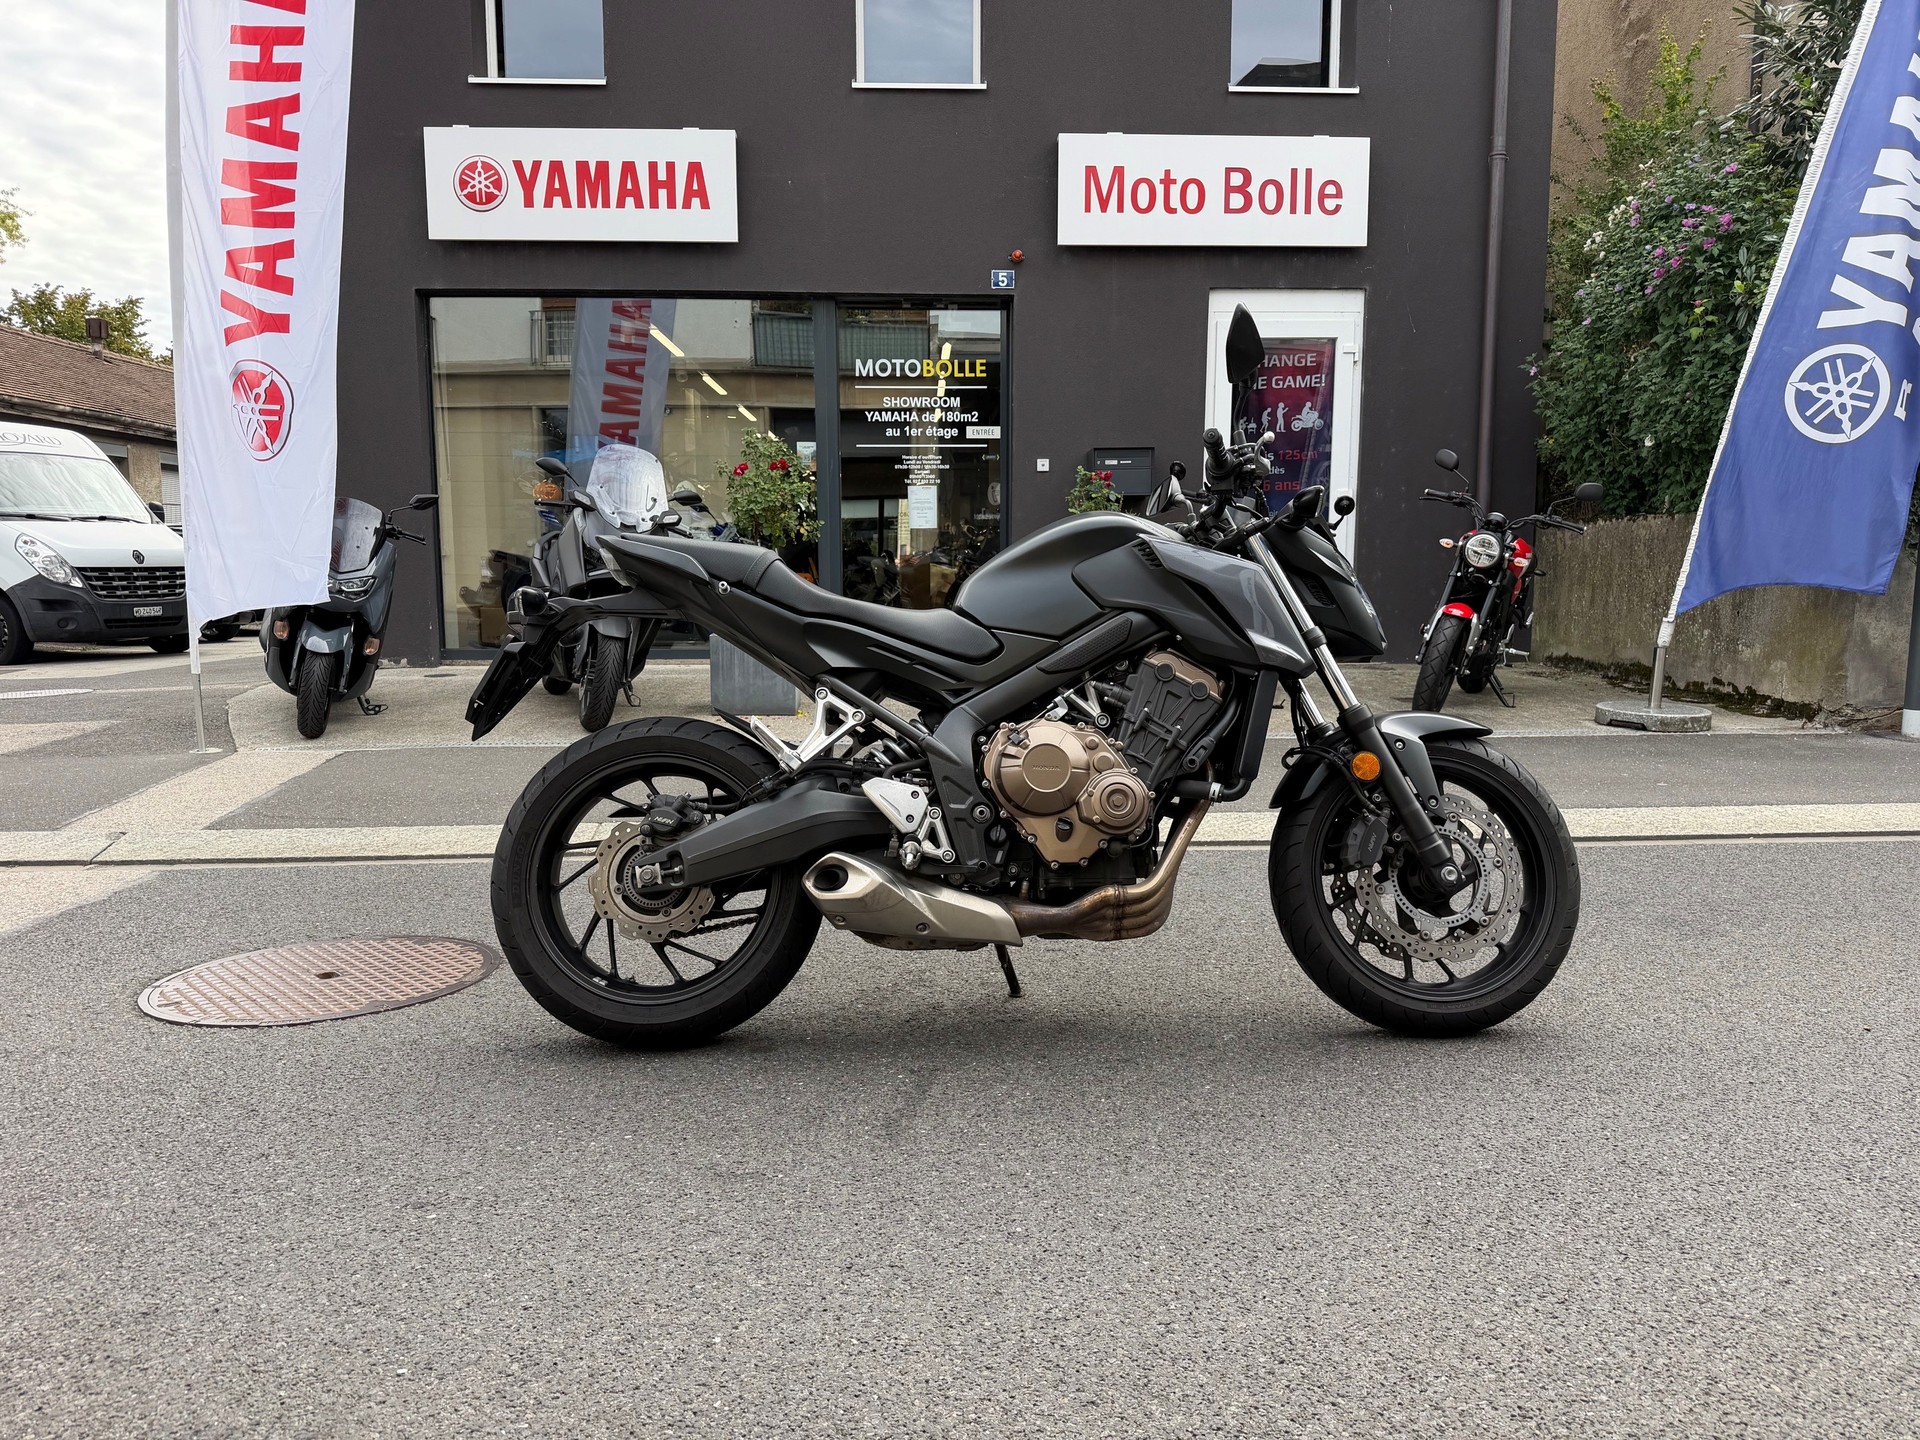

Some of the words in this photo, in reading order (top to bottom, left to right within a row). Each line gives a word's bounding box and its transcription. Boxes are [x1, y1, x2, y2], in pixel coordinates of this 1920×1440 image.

[220, 0, 306, 347] YAMAH
[511, 159, 711, 210] YAMAHA
[1083, 164, 1206, 215] Moto
[1223, 166, 1344, 216] Bolle
[998, 272, 1008, 287] 5
[855, 358, 987, 378] MOTOBOLLE
[1257, 353, 1317, 368] HANGE
[598, 299, 653, 450] AMAHA
[883, 396, 961, 408] SHOWROOM
[865, 411, 919, 422] YAMAHA
[921, 411, 937, 422] de
[941, 411, 979, 422] 180m2
[885, 427, 900, 437] au
[904, 425, 923, 437] 1er
[926, 425, 959, 439] étage
[971, 427, 995, 436] ENTRÉE
